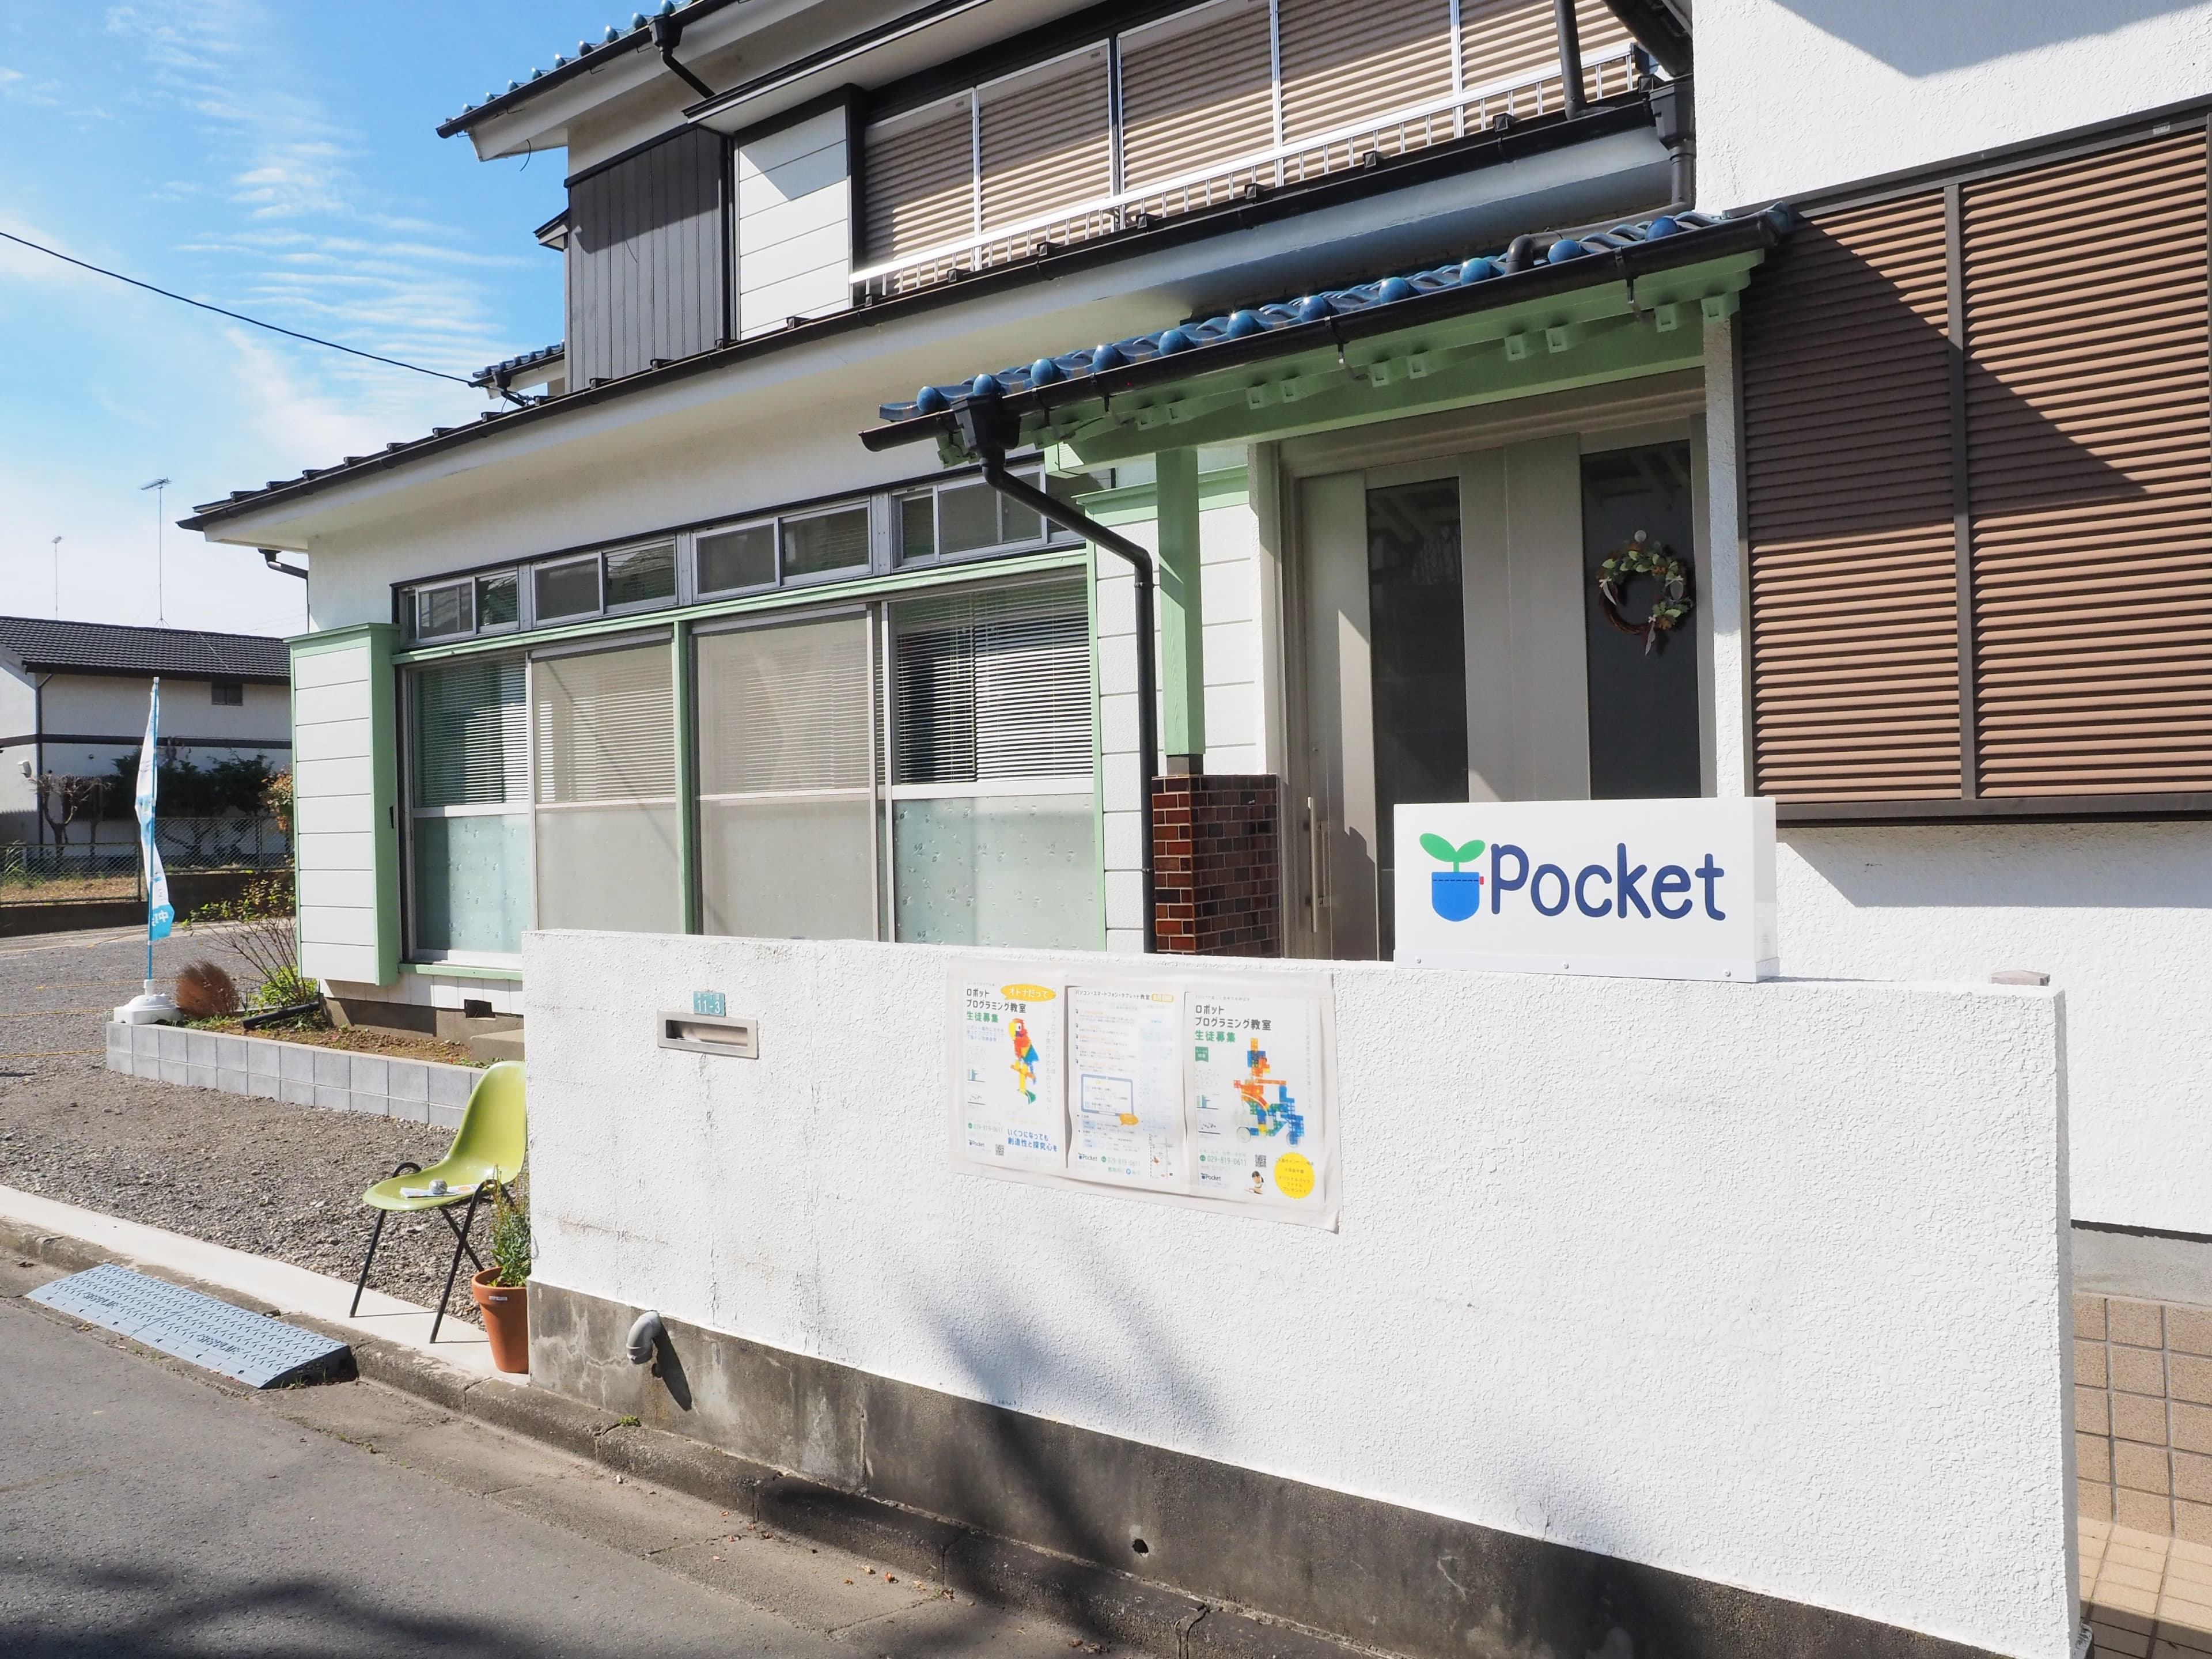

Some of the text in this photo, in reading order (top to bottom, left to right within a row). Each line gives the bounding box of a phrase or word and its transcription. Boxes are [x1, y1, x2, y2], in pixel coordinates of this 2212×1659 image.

[1491, 843, 1726, 921] Pocket
[966, 988, 990, 998] ロボット
[1009, 987, 1048, 999] オトナだって
[697, 1000, 721, 1014] 11-3
[966, 999, 1027, 1014] プログラミング教室
[1195, 1004, 1225, 1015] ロボット
[966, 1010, 999, 1023] 生徒募集
[1195, 1016, 1272, 1031] プログラミング教室
[1195, 1029, 1236, 1043] 生徒募集
[1007, 1128, 1049, 1142] いくつになっても
[1082, 1153, 1097, 1161] Pocket
[1207, 1155, 1247, 1166] 029-819-0611
[1205, 1173, 1221, 1182] Pocket
